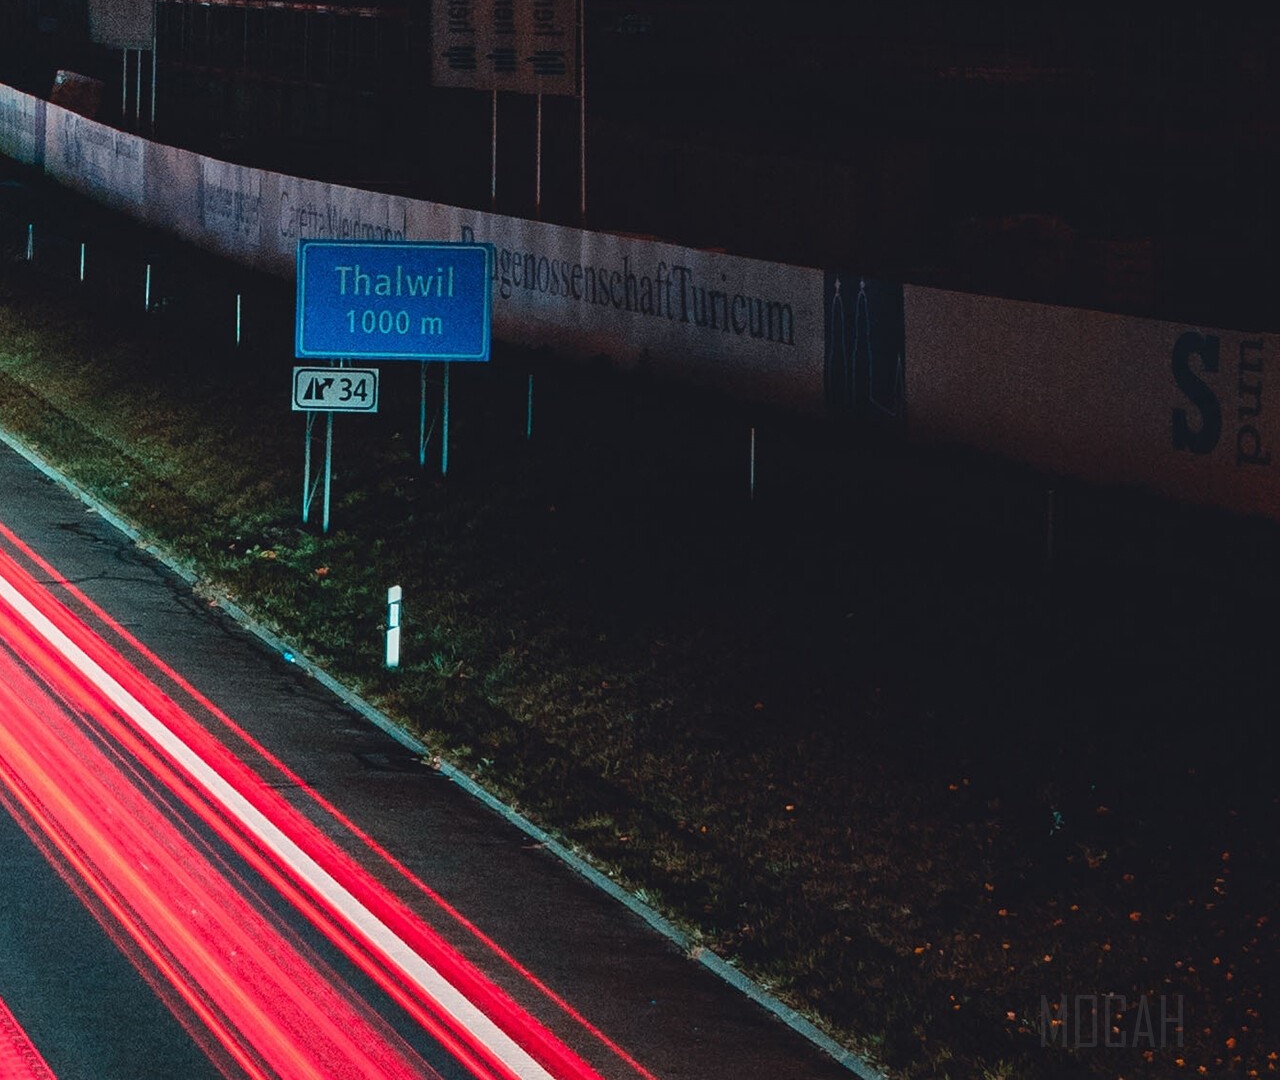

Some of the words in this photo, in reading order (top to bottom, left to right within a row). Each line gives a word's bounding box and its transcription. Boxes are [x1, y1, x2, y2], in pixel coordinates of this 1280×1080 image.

[335, 263, 454, 298] Thalwil
[346, 309, 410, 335] 1000
[420, 315, 444, 335] m
[338, 377, 368, 402] 34
[1172, 331, 1221, 455] S
[1238, 339, 1271, 466] und
